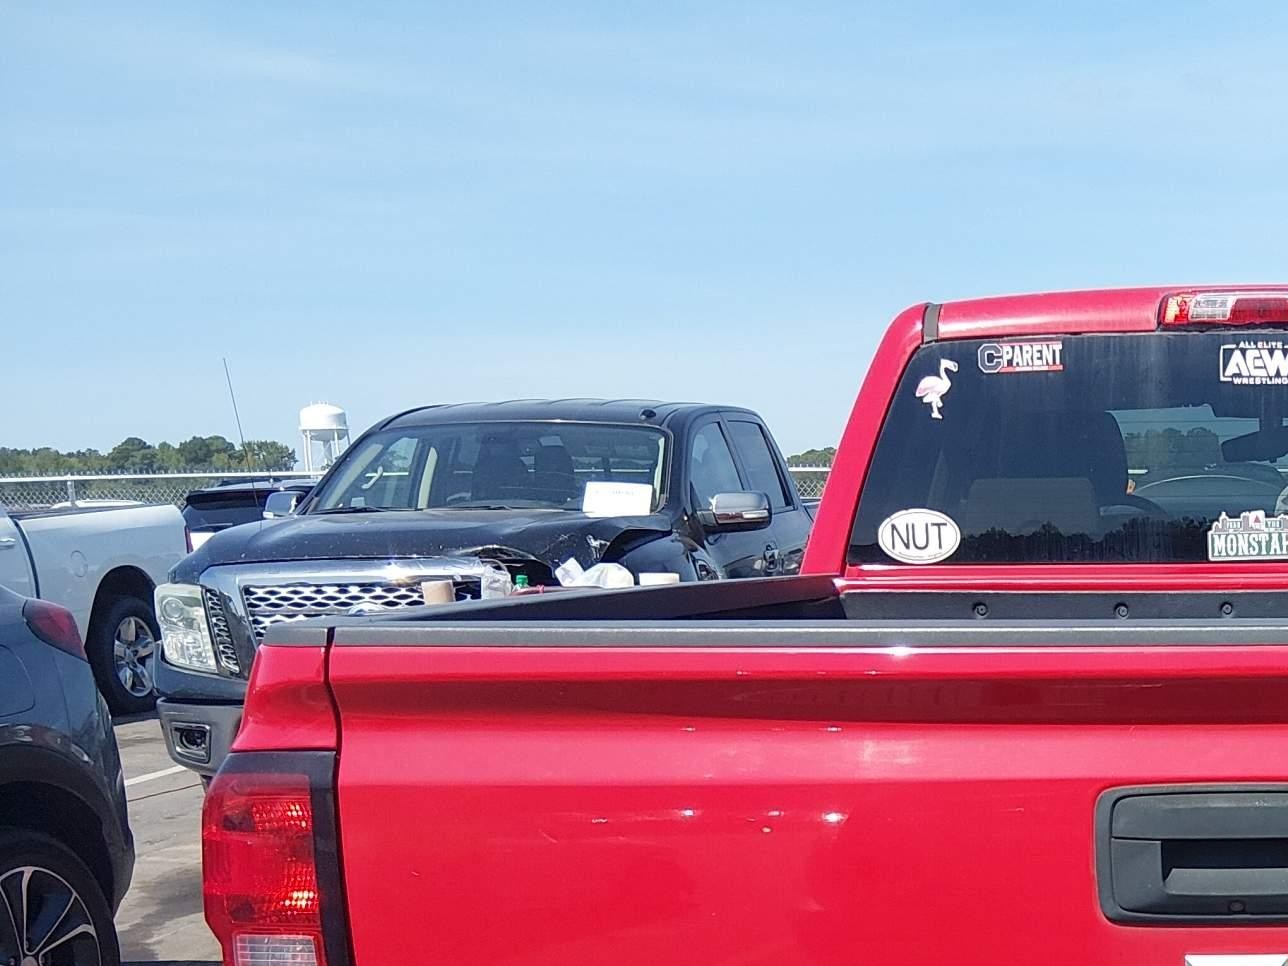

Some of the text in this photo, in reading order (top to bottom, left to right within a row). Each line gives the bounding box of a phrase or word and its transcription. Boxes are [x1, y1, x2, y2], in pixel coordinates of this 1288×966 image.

[1238, 340, 1282, 349] ALL ELITE
[1002, 344, 1063, 368] PARENT
[1232, 377, 1288, 385] WRESTLING
[891, 522, 948, 550] NUT
